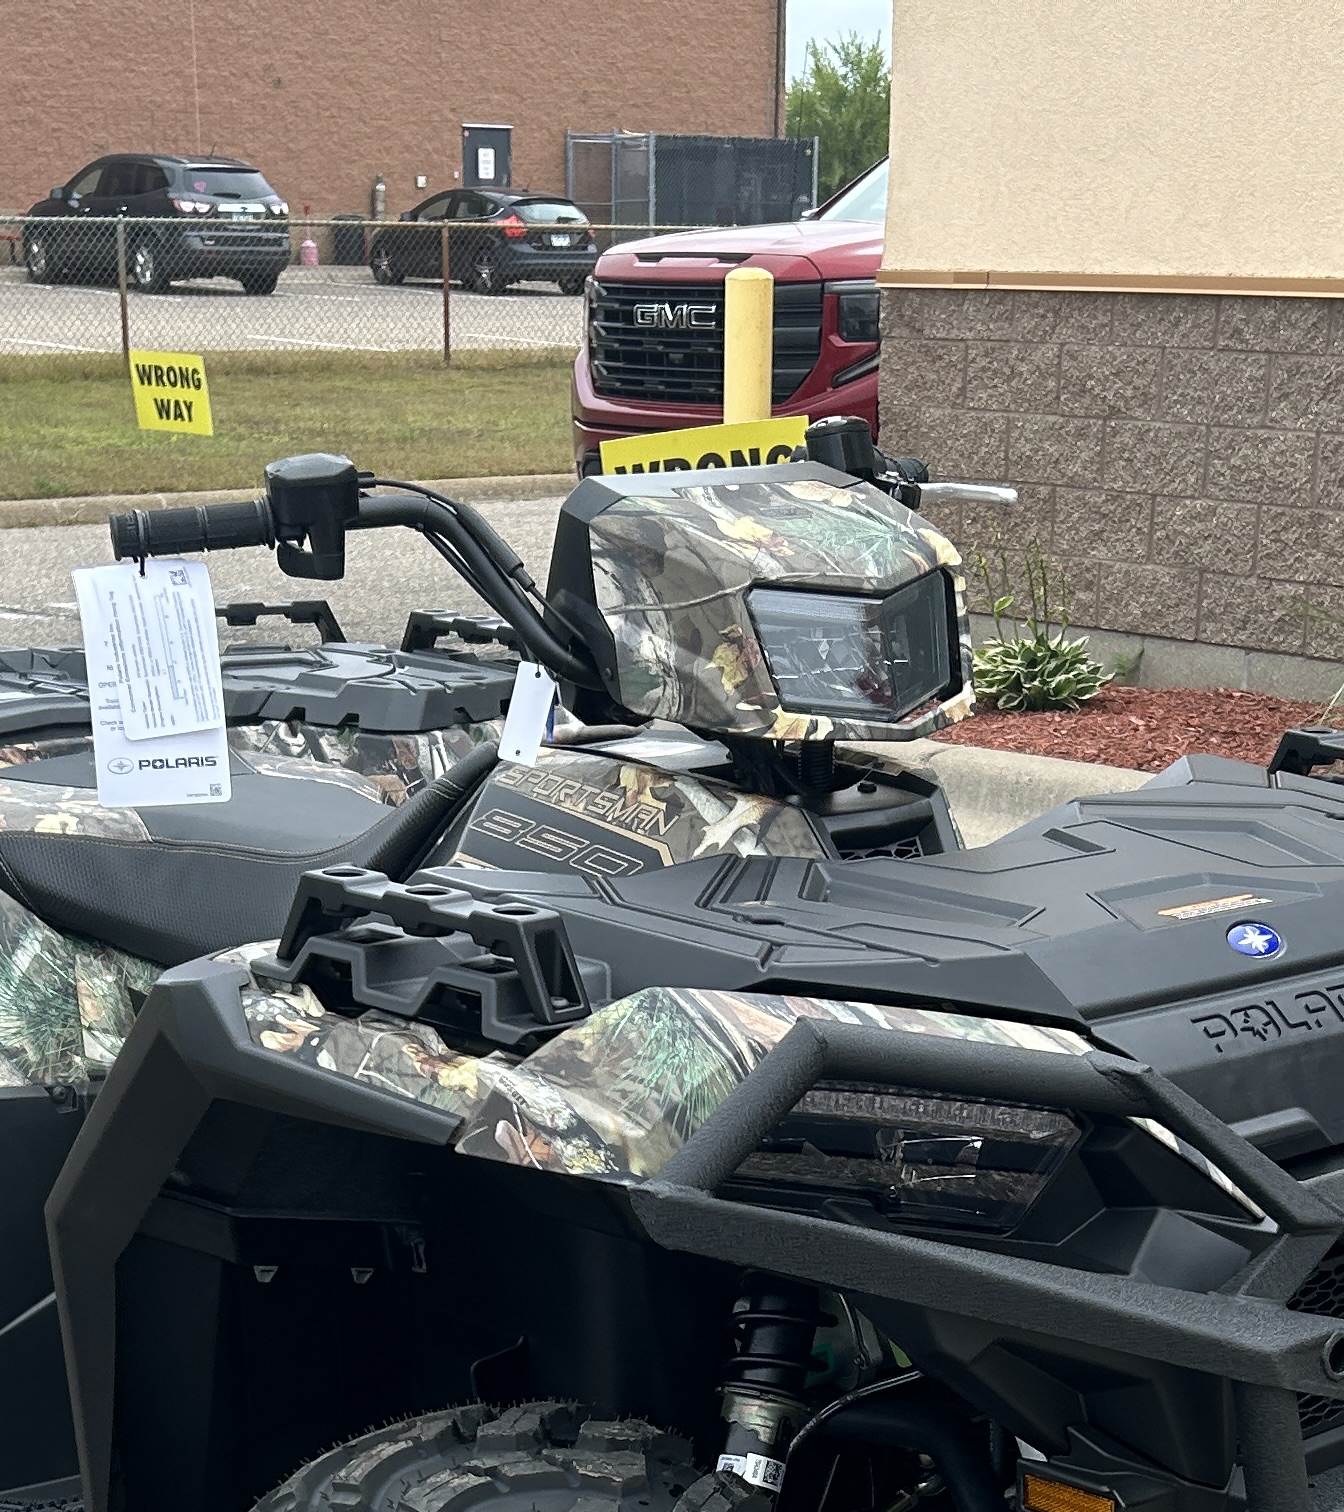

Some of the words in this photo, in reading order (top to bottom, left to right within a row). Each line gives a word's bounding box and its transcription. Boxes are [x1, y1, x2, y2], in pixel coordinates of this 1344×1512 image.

[633, 303, 717, 329] GMC
[135, 363, 202, 391] WRONG
[153, 397, 194, 423] WAY
[138, 755, 217, 771] POLARIS
[497, 765, 681, 838] SPORTSMAN
[470, 808, 645, 876] 850
